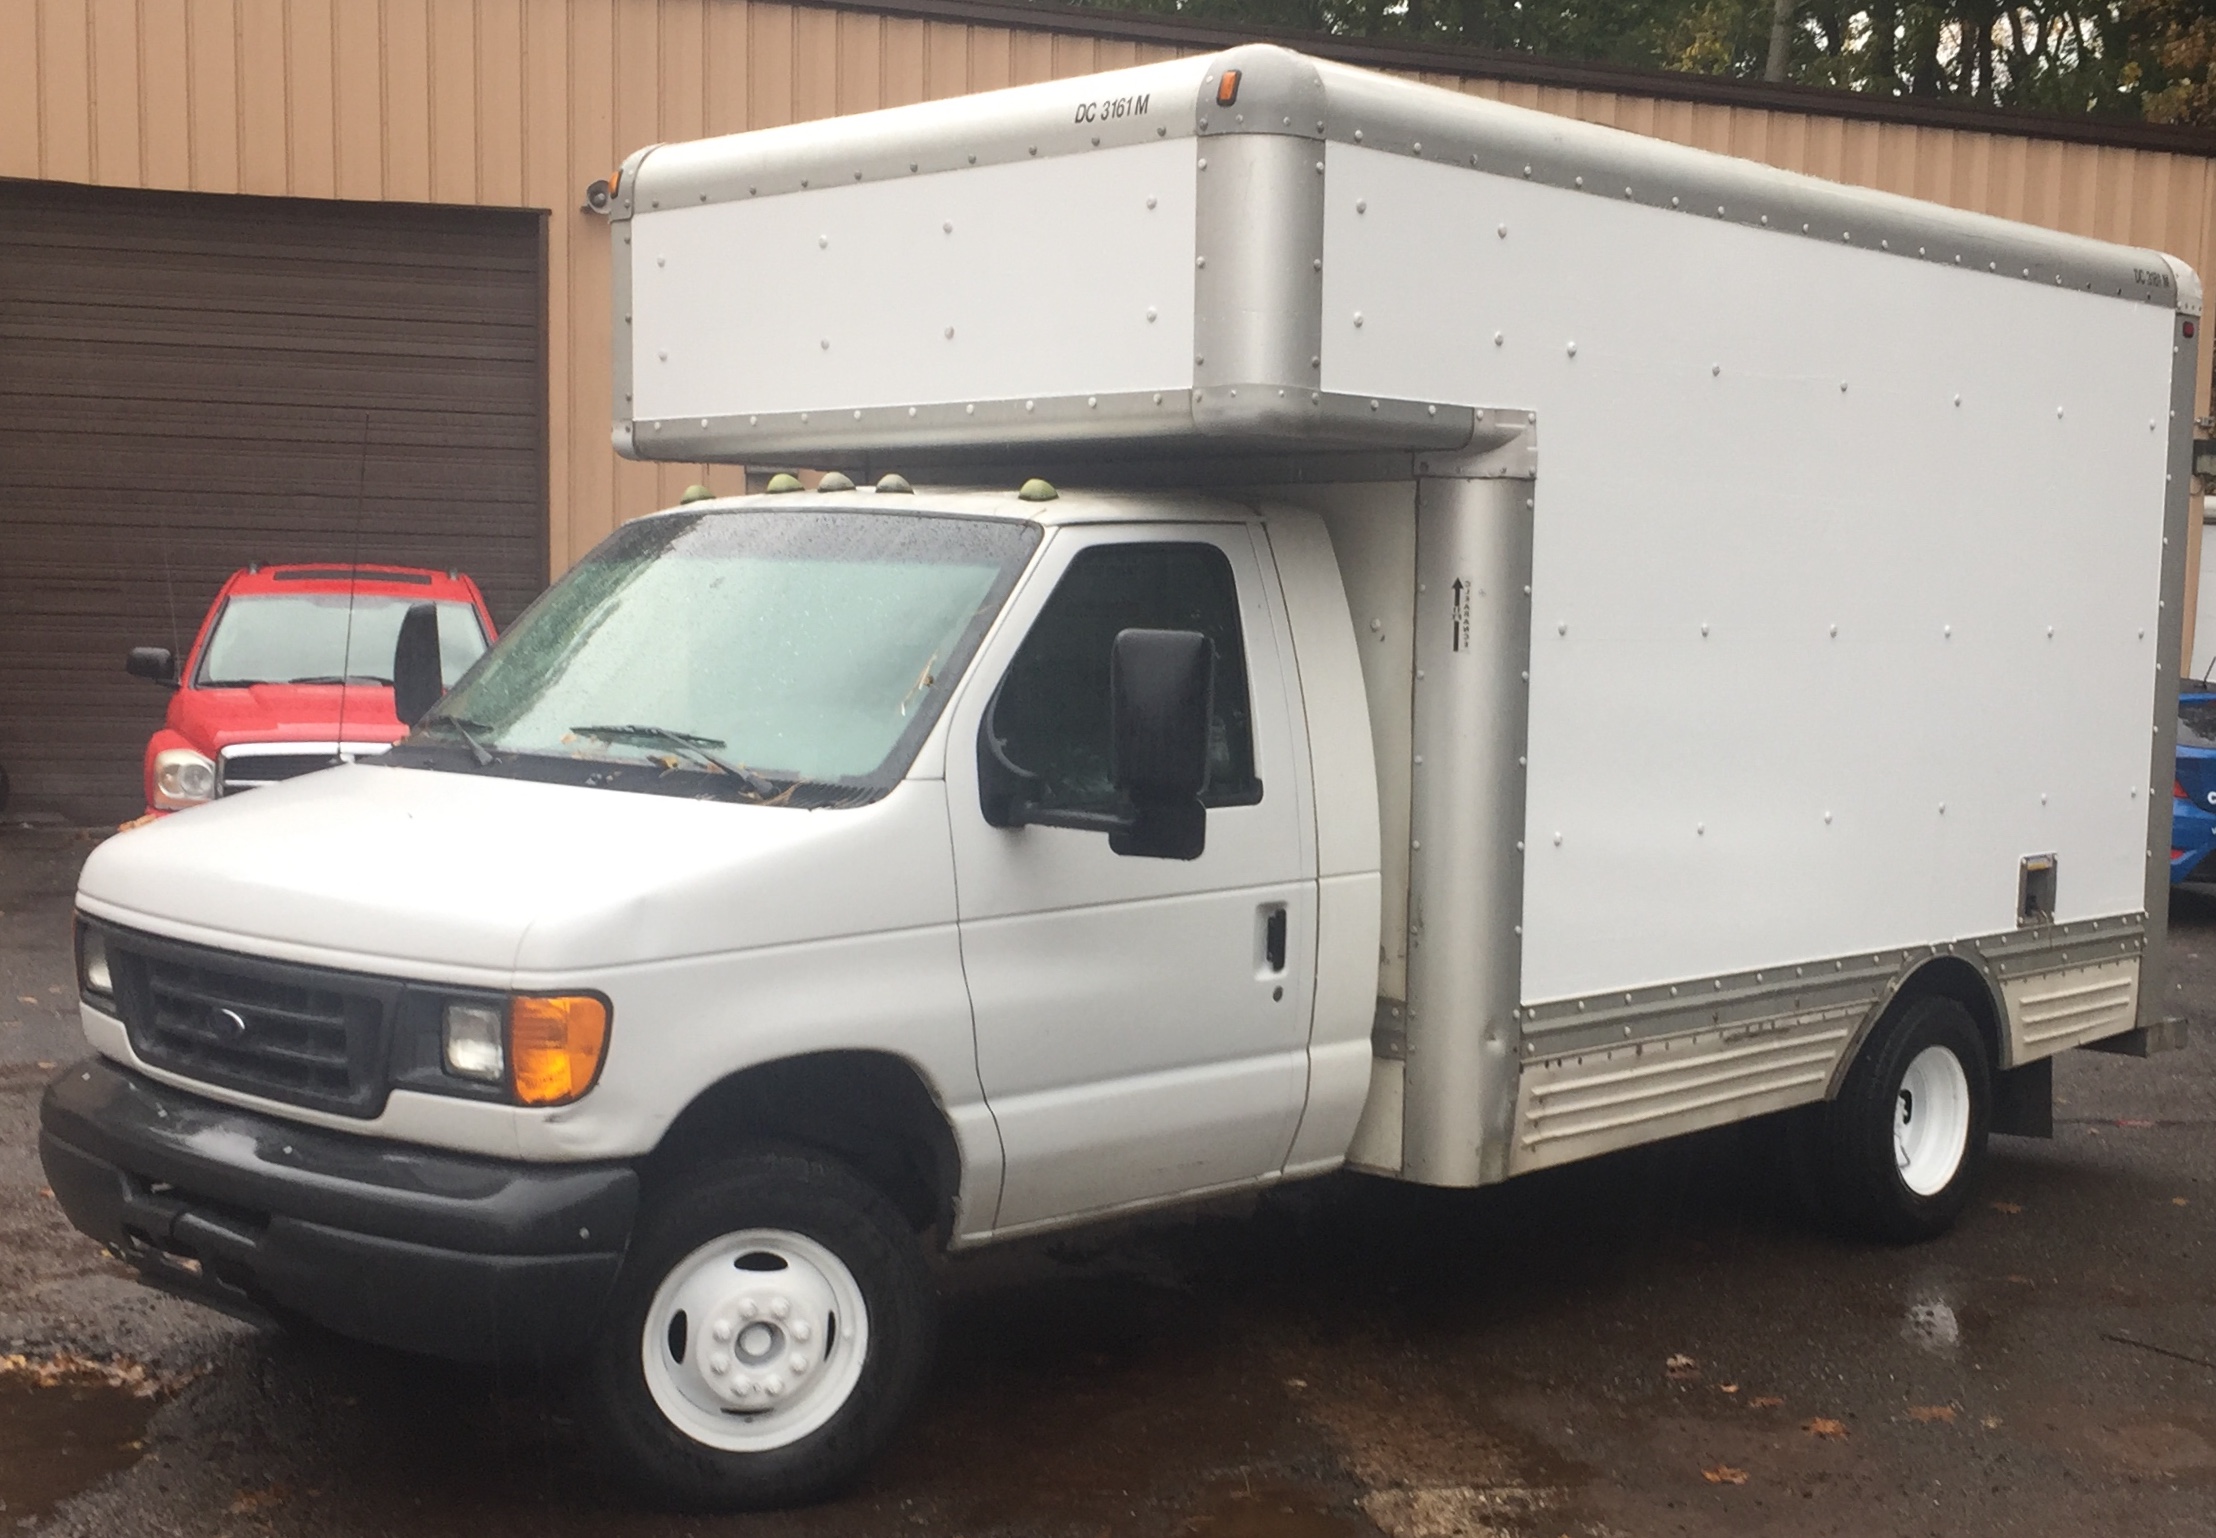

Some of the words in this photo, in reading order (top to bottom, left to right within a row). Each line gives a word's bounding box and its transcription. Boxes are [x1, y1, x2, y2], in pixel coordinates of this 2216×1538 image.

[1075, 102, 1097, 124] DC
[1101, 96, 1133, 121] 3161
[1134, 93, 1151, 116] M
